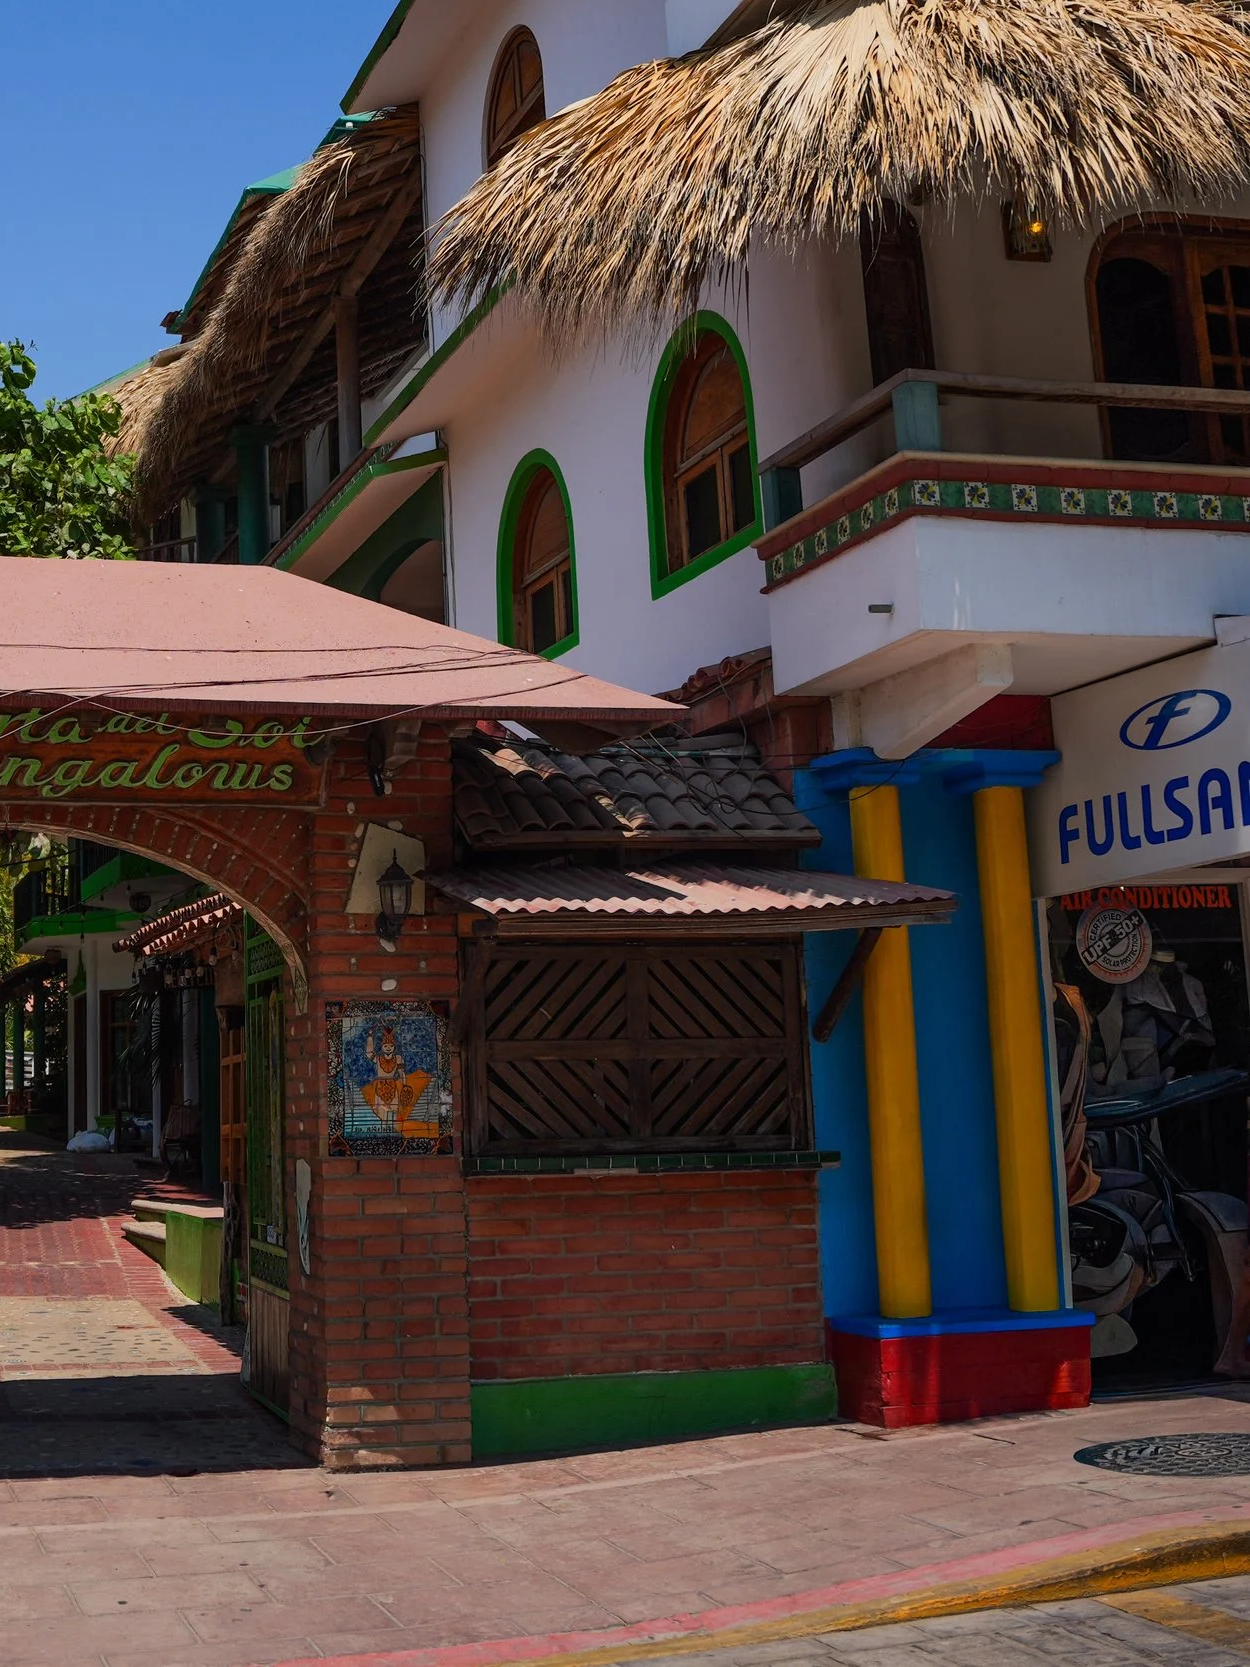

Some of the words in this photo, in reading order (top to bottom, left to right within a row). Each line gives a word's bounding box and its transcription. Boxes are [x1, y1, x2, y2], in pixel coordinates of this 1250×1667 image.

[95, 712, 179, 734] del
[1060, 891, 1094, 910] AIR
[1097, 885, 1233, 910] CONDITIONER
[1082, 935, 1115, 963] UPF
[1115, 914, 1143, 941] 50+
[1091, 912, 1122, 941] CERTIFIED
[1102, 956, 1121, 968] SOLAR
[1121, 933, 1140, 967] PROTECTION
